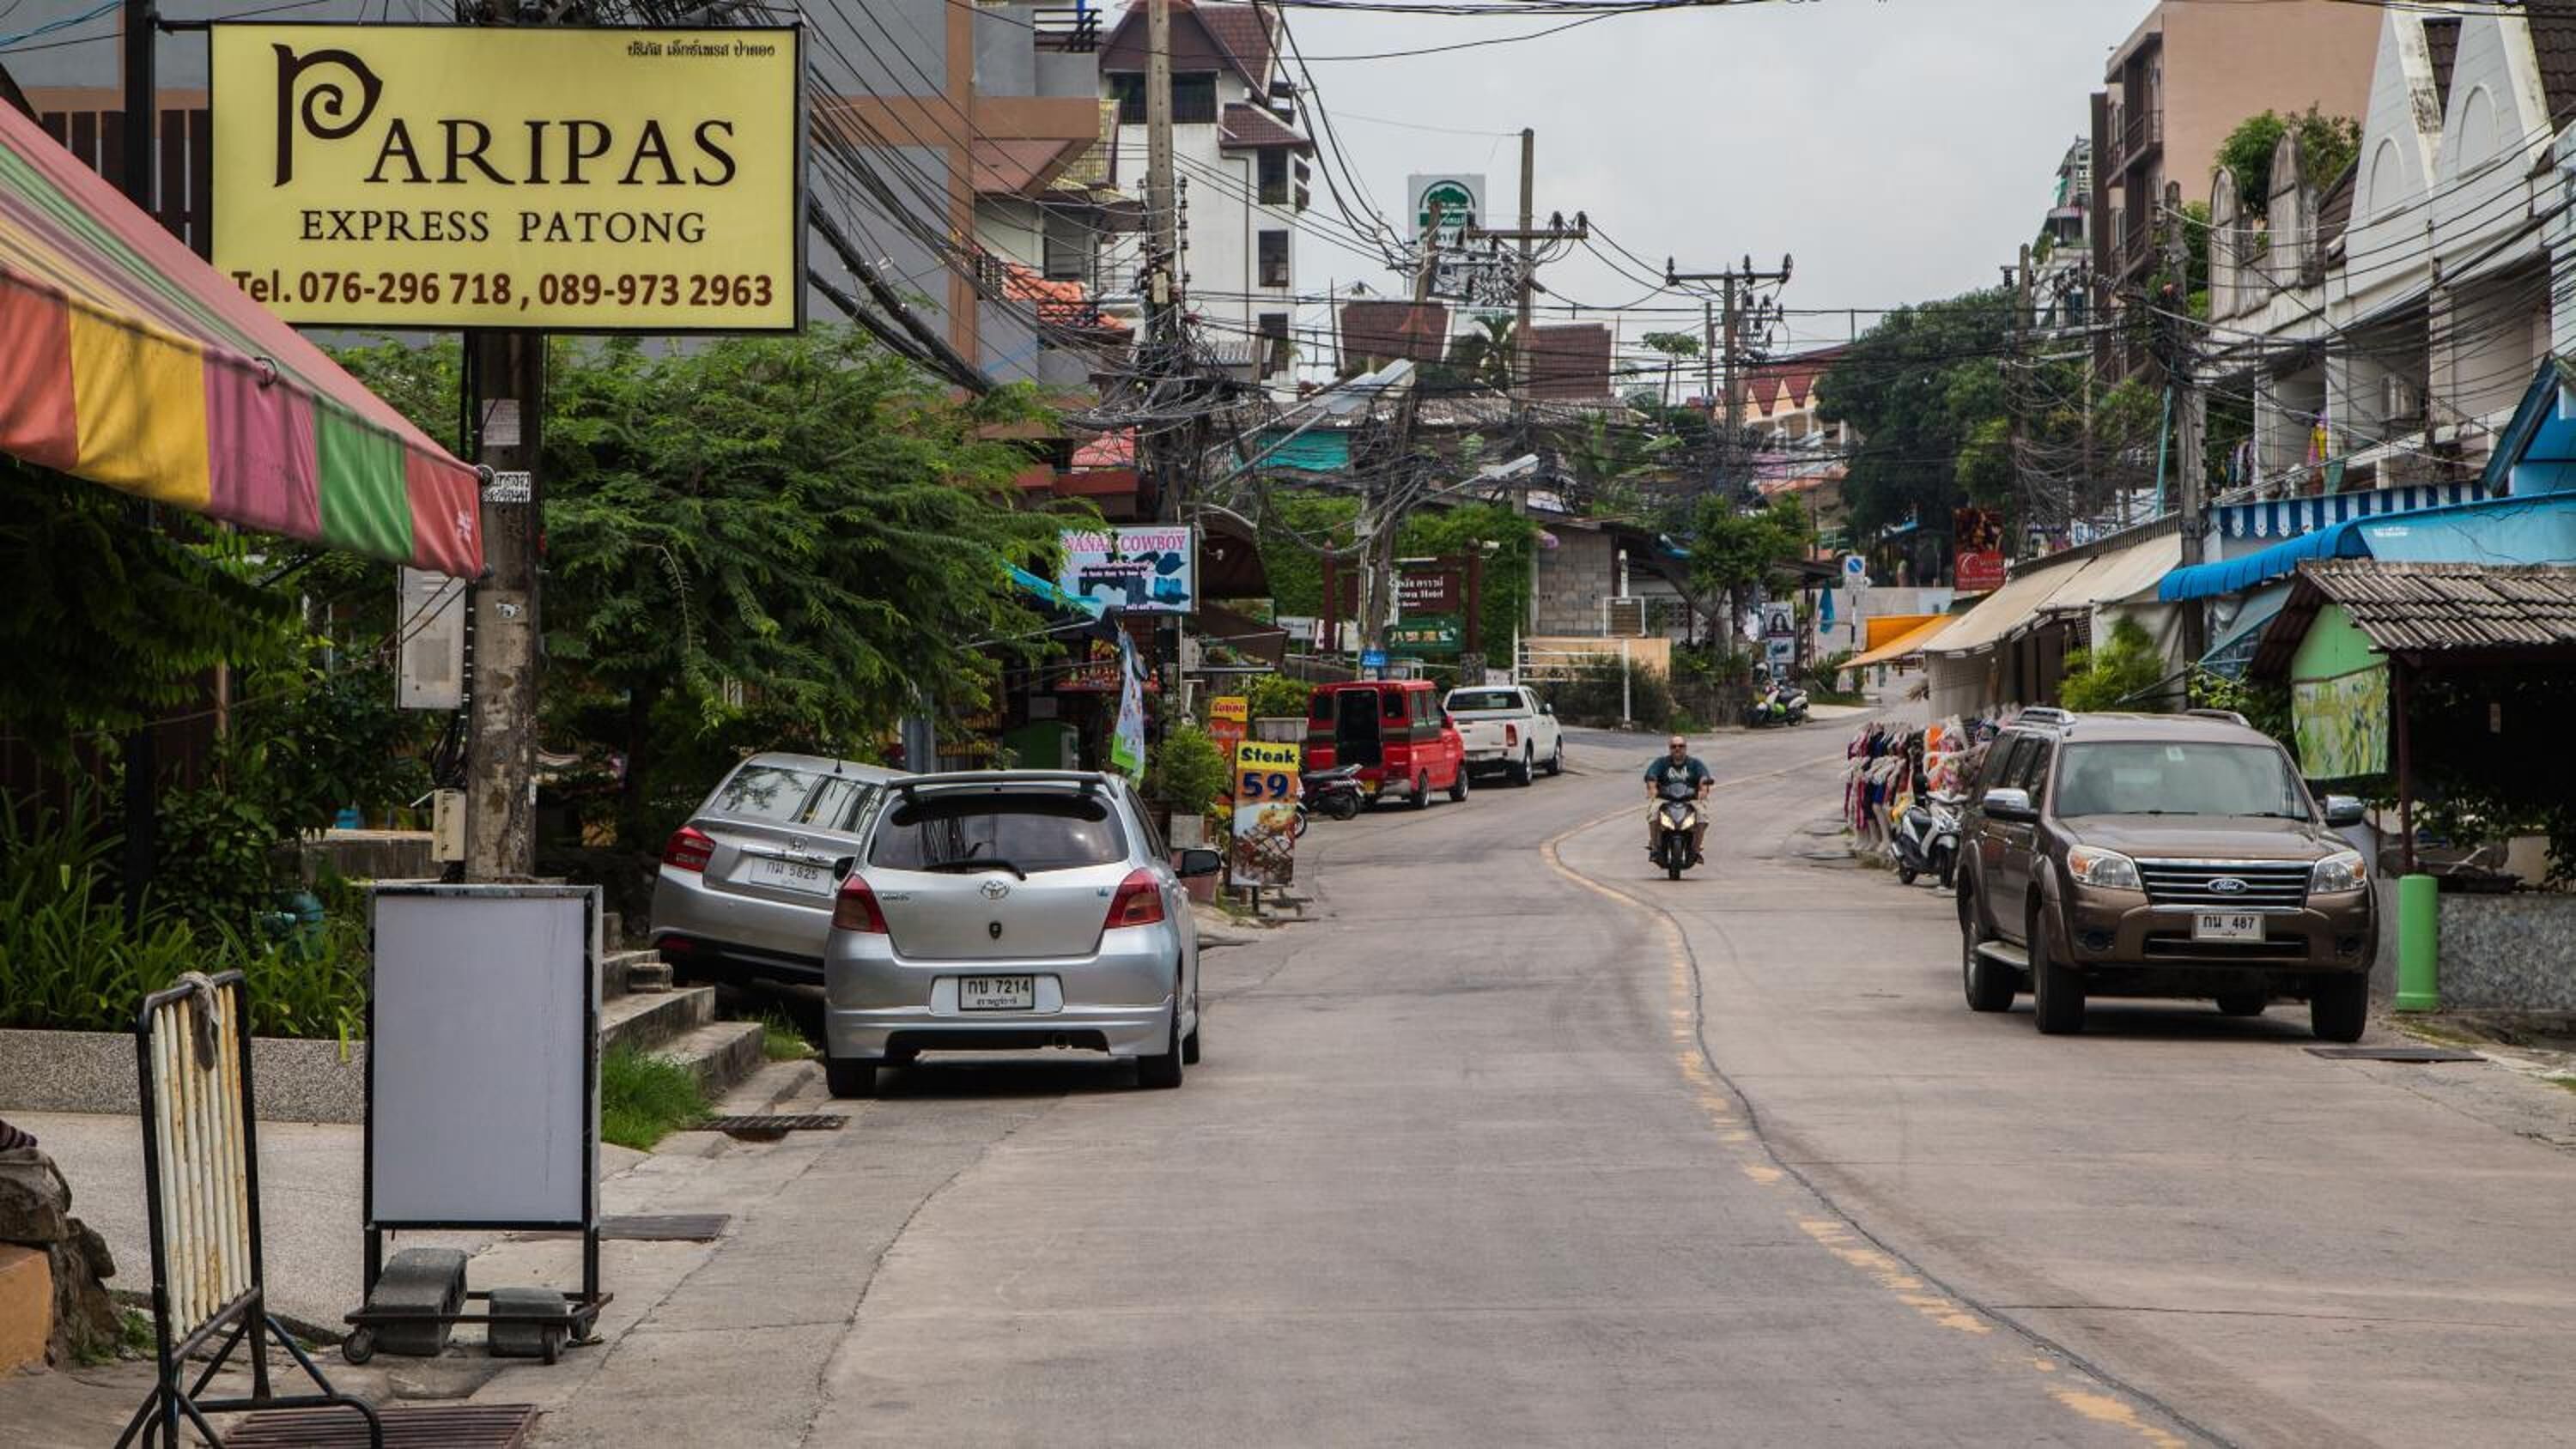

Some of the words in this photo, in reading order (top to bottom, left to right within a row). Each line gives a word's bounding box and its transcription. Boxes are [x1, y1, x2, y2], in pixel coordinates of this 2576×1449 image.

[272, 42, 737, 188] PARIPAS
[300, 210, 489, 242] EXPRESS
[519, 211, 705, 244] PATONG
[1121, 535, 1186, 551] COWBOY
[1241, 747, 1295, 763] Steak
[1242, 772, 1289, 797] 59
[996, 979, 1030, 994] 7214
